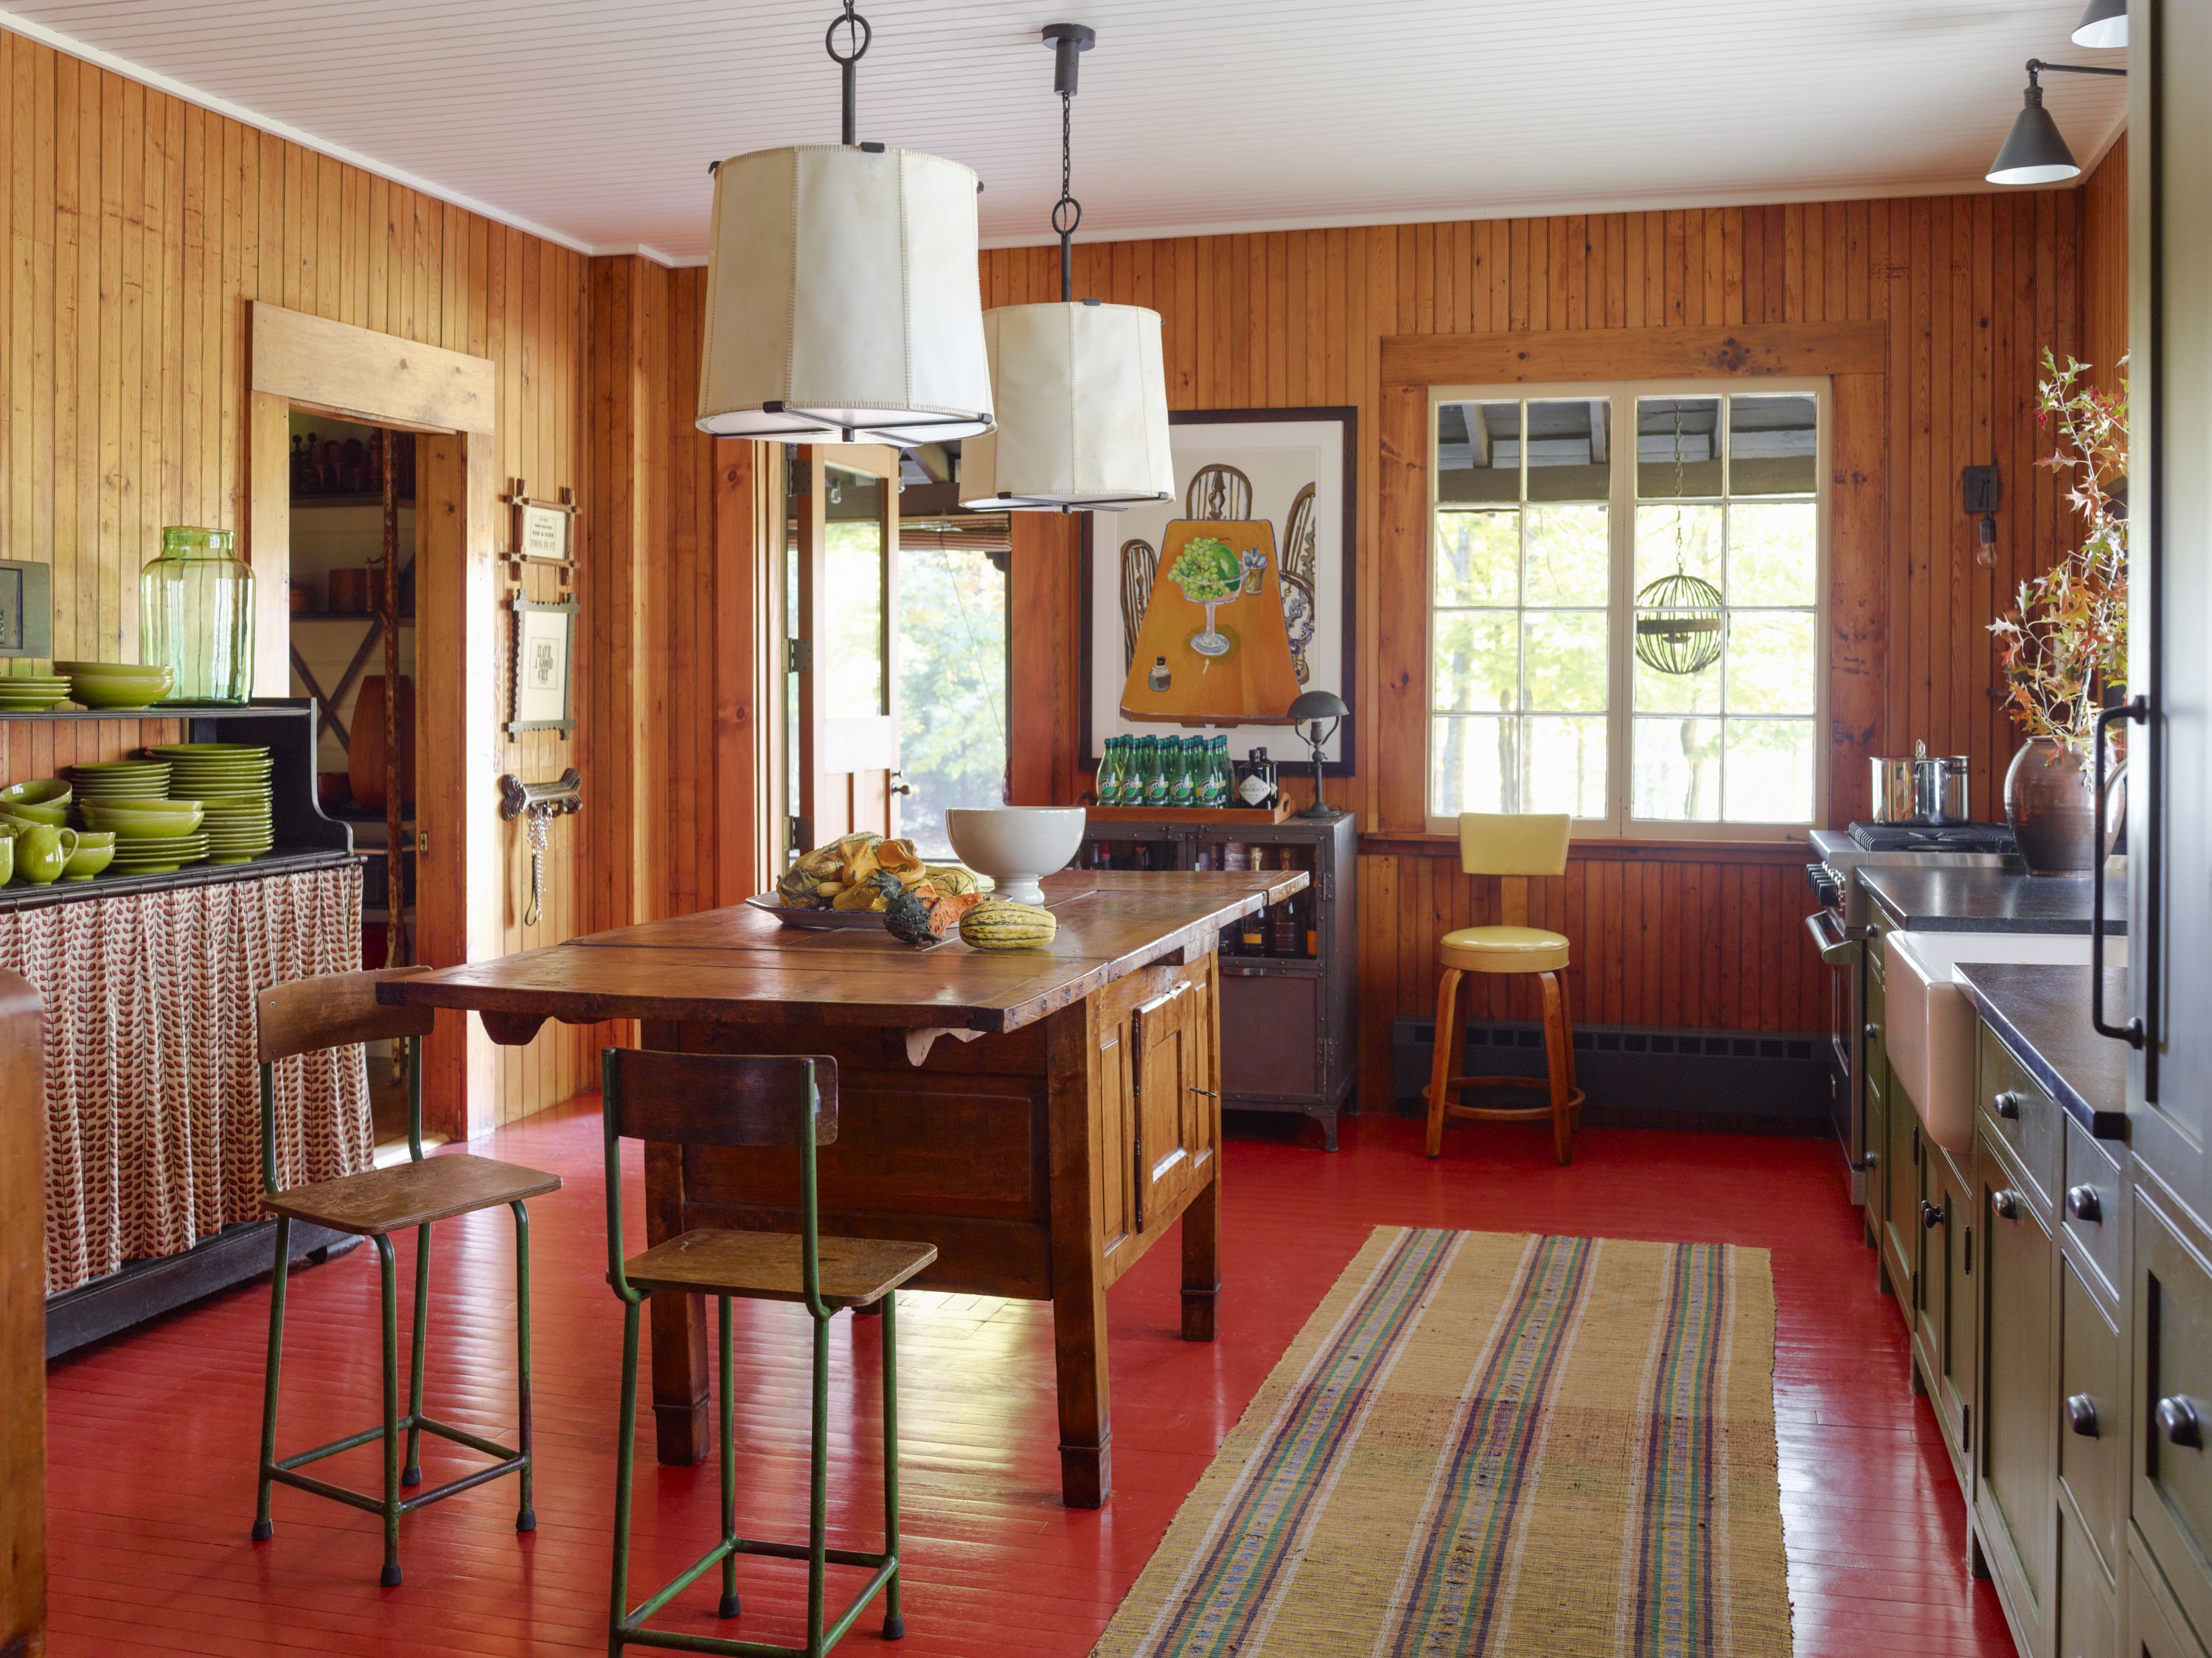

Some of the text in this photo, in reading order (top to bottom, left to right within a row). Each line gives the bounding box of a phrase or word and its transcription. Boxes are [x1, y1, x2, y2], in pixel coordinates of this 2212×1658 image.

[531, 539, 542, 547] THIS
[550, 541, 554, 549] IT
[538, 645, 552, 657] HAVE
[535, 657, 553, 670] A GOOD
[538, 669, 549, 681] CRY
